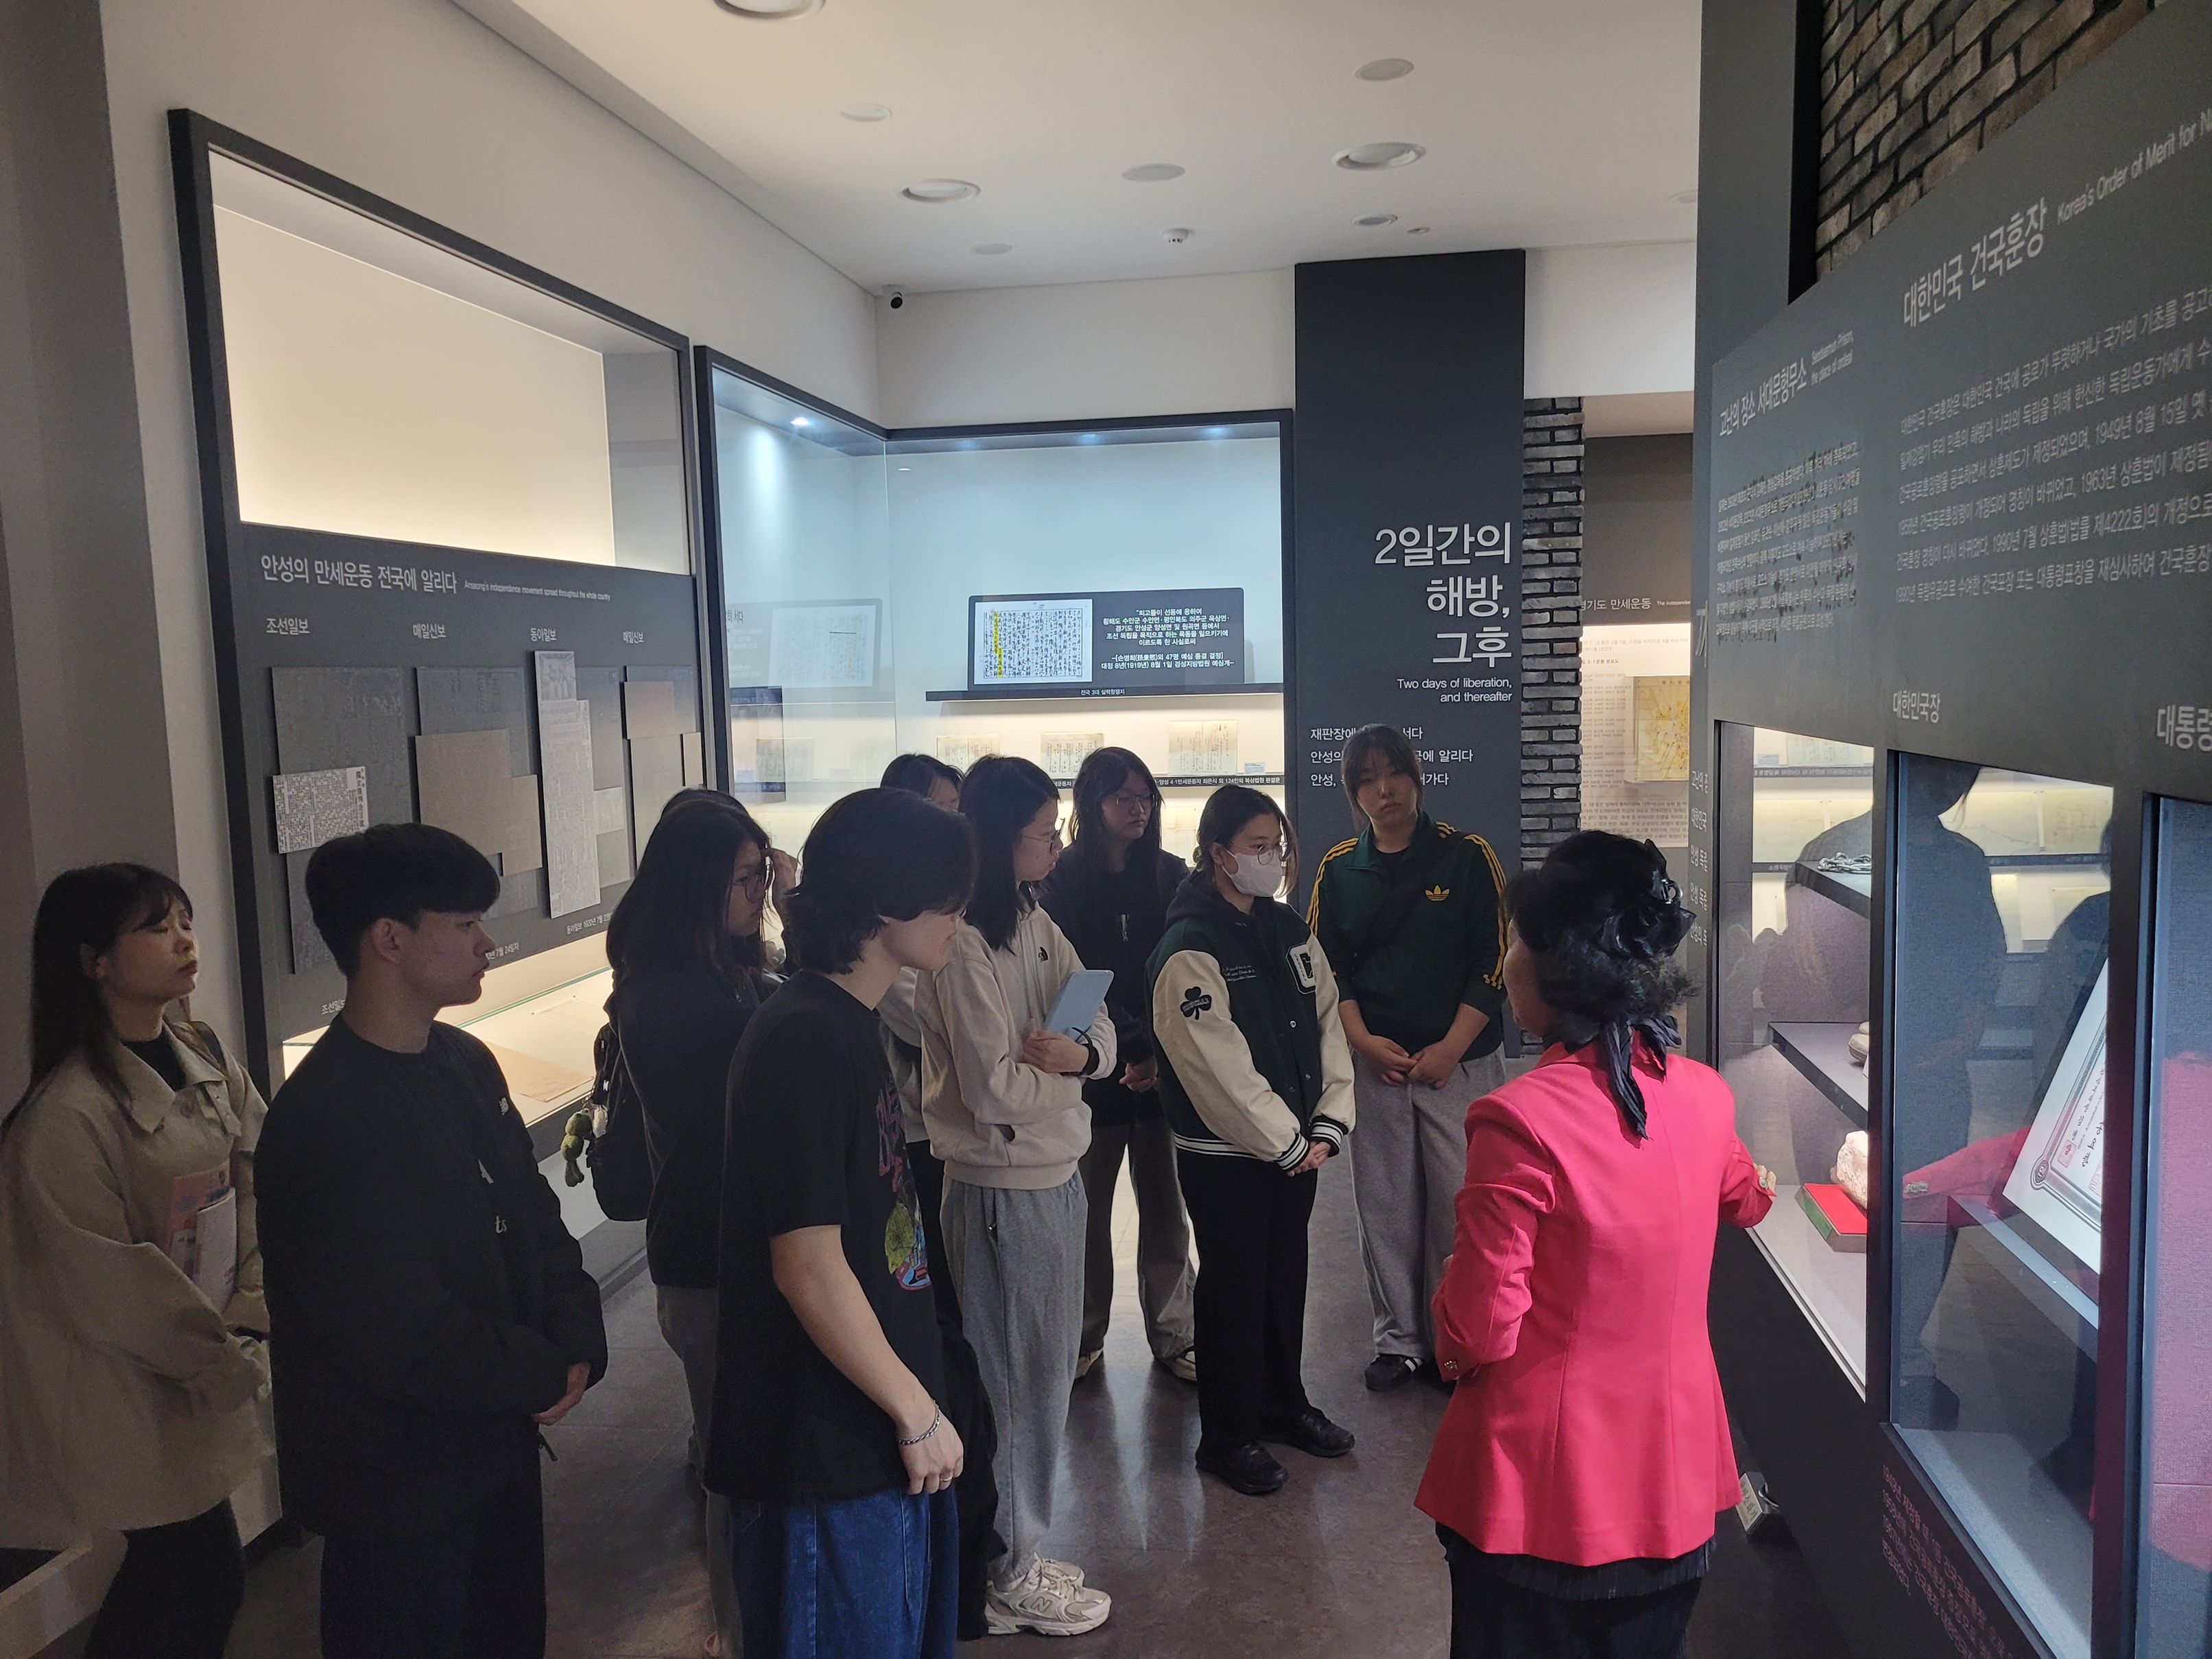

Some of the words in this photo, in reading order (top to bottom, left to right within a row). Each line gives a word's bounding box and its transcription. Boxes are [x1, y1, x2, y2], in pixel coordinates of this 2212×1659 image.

[2097, 167, 2129, 197] Order
[2131, 151, 2145, 179] of
[2146, 135, 2176, 172] Merit
[2178, 123, 2197, 150] for
[1903, 253, 1963, 327] 대한민국
[1970, 197, 2048, 291] 건국훈장
[1962, 381, 1993, 411] 대한민국
[1995, 368, 2019, 397] 건국에
[2021, 355, 2047, 386] 공로가
[2051, 332, 2100, 374] 뚜렷하거나
[2104, 316, 2138, 353] 국가의
[2141, 299, 2176, 337] 기초를
[1720, 399, 1739, 437] 고난의
[1741, 390, 1756, 427] 장소
[1757, 357, 1807, 414] 서대문형무소
[1995, 408, 2020, 435] 나라의
[2022, 397, 2049, 427] 독립을
[2052, 389, 2071, 416] 위해
[2074, 375, 2105, 408] 헌신한
[2108, 343, 2193, 396] 독립운동가에게
[1988, 446, 2029, 477] 상훈제도가
[2032, 426, 2091, 464] 제정되었으며,
[2095, 414, 2131, 446] 1949년
[2135, 405, 2155, 435] 8월
[2161, 396, 2187, 427] 15일
[2191, 390, 2207, 418] 옛
[2008, 486, 2034, 511] 명칭이
[2036, 475, 2076, 505] 바뀌었고,
[2080, 464, 2116, 494] 1963년
[2119, 451, 2165, 486] 상훈법이
[1992, 529, 2021, 553] 1990년
[2023, 526, 2037, 549] 7월
[2039, 516, 2090, 546] 상훈법(법률
[2093, 503, 2158, 537] 제4222호)의
[1375, 521, 1511, 567] 2일간의
[261, 555, 309, 583] 안성의
[314, 560, 373, 588] 만세운동
[377, 566, 418, 591] 전국에
[421, 569, 457, 594] 알리다
[1982, 571, 2014, 594] 건국포장
[2016, 568, 2034, 590] 또는
[2036, 560, 2095, 588] 대통령표창을
[2097, 551, 2155, 582] 재심사하여
[522, 585, 543, 595] movement
[1426, 575, 1510, 618] 해방,
[1610, 597, 1652, 610] 만세운동
[265, 617, 311, 636] 조선일보
[412, 623, 447, 639] 매일신보
[530, 628, 558, 642] 동아일보
[1115, 624, 1133, 632] 경기도
[1134, 623, 1152, 632] 안성군
[1154, 623, 1172, 631] 양성면
[1174, 623, 1180, 631] 및
[1182, 622, 1200, 630] 원곡면
[1139, 631, 1164, 639] 목적으로
[1165, 630, 1178, 638] 하는
[622, 631, 645, 644] 매일신보
[1139, 638, 1162, 647] 이르도록
[1432, 626, 1512, 668] 그후
[1115, 661, 1149, 669] 8년(1919년)
[1174, 660, 1210, 668] 경성지방법원
[1209, 652, 1224, 660] 결정]
[1397, 679, 1419, 689] Two
[1422, 678, 1447, 691] days
[1450, 677, 1460, 688] of
[1463, 676, 1512, 689] liberation,
[1440, 692, 1460, 702] and
[1464, 691, 1512, 702] thereafter
[1893, 690, 1940, 724] 대한민국장
[1310, 727, 1357, 741] 재판장에
[1438, 749, 1474, 763] 알리다
[1311, 774, 1336, 787] 안성,
[1691, 770, 1704, 792] 고난의
[1691, 807, 1707, 833] 대한민국
[566, 922, 583, 935] 동아일보
[496, 947, 504, 957] 7월
[504, 942, 520, 954] 24일자
